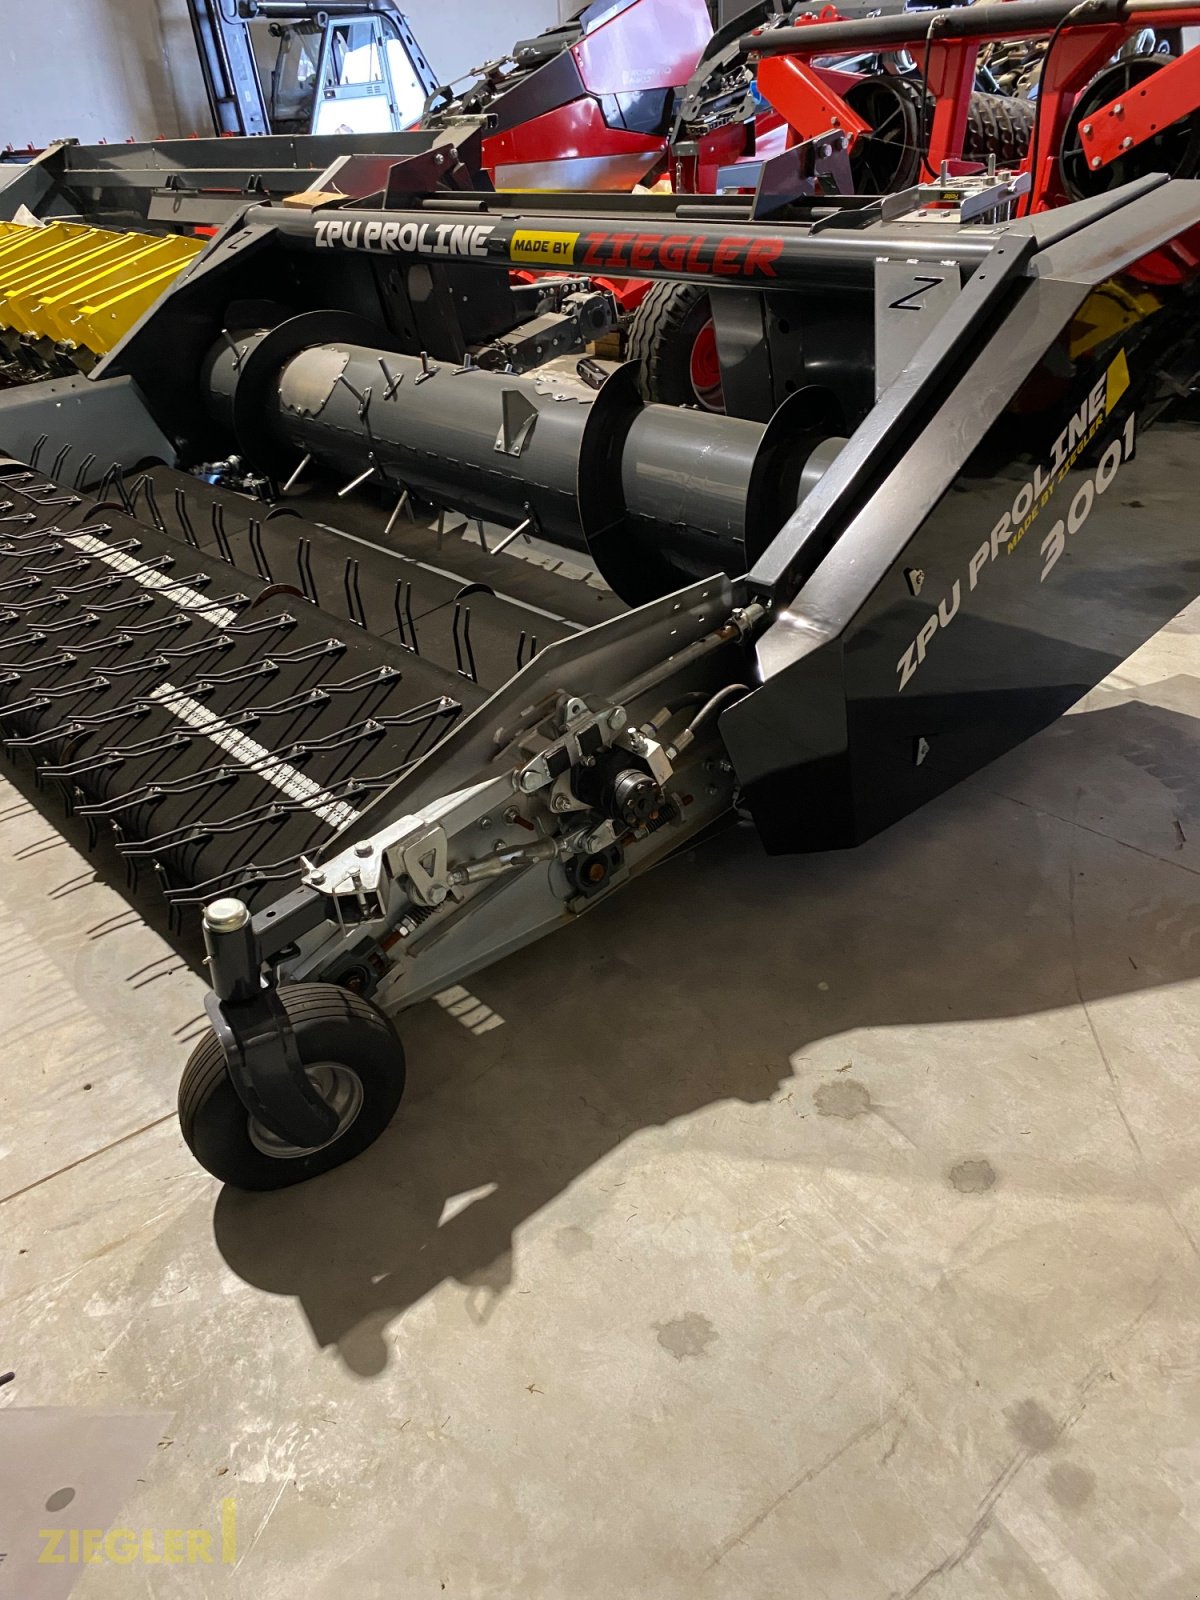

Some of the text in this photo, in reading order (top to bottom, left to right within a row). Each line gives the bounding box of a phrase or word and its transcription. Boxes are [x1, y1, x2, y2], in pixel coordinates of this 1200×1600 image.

[314, 220, 495, 257] ZPU PROLINE
[514, 231, 785, 277] MADE BY ZIEGLER
[896, 371, 1107, 693] ZPU PROLINE
[1007, 412, 1104, 555] MADE BY ZIEGLER
[1040, 411, 1136, 583] 3001
